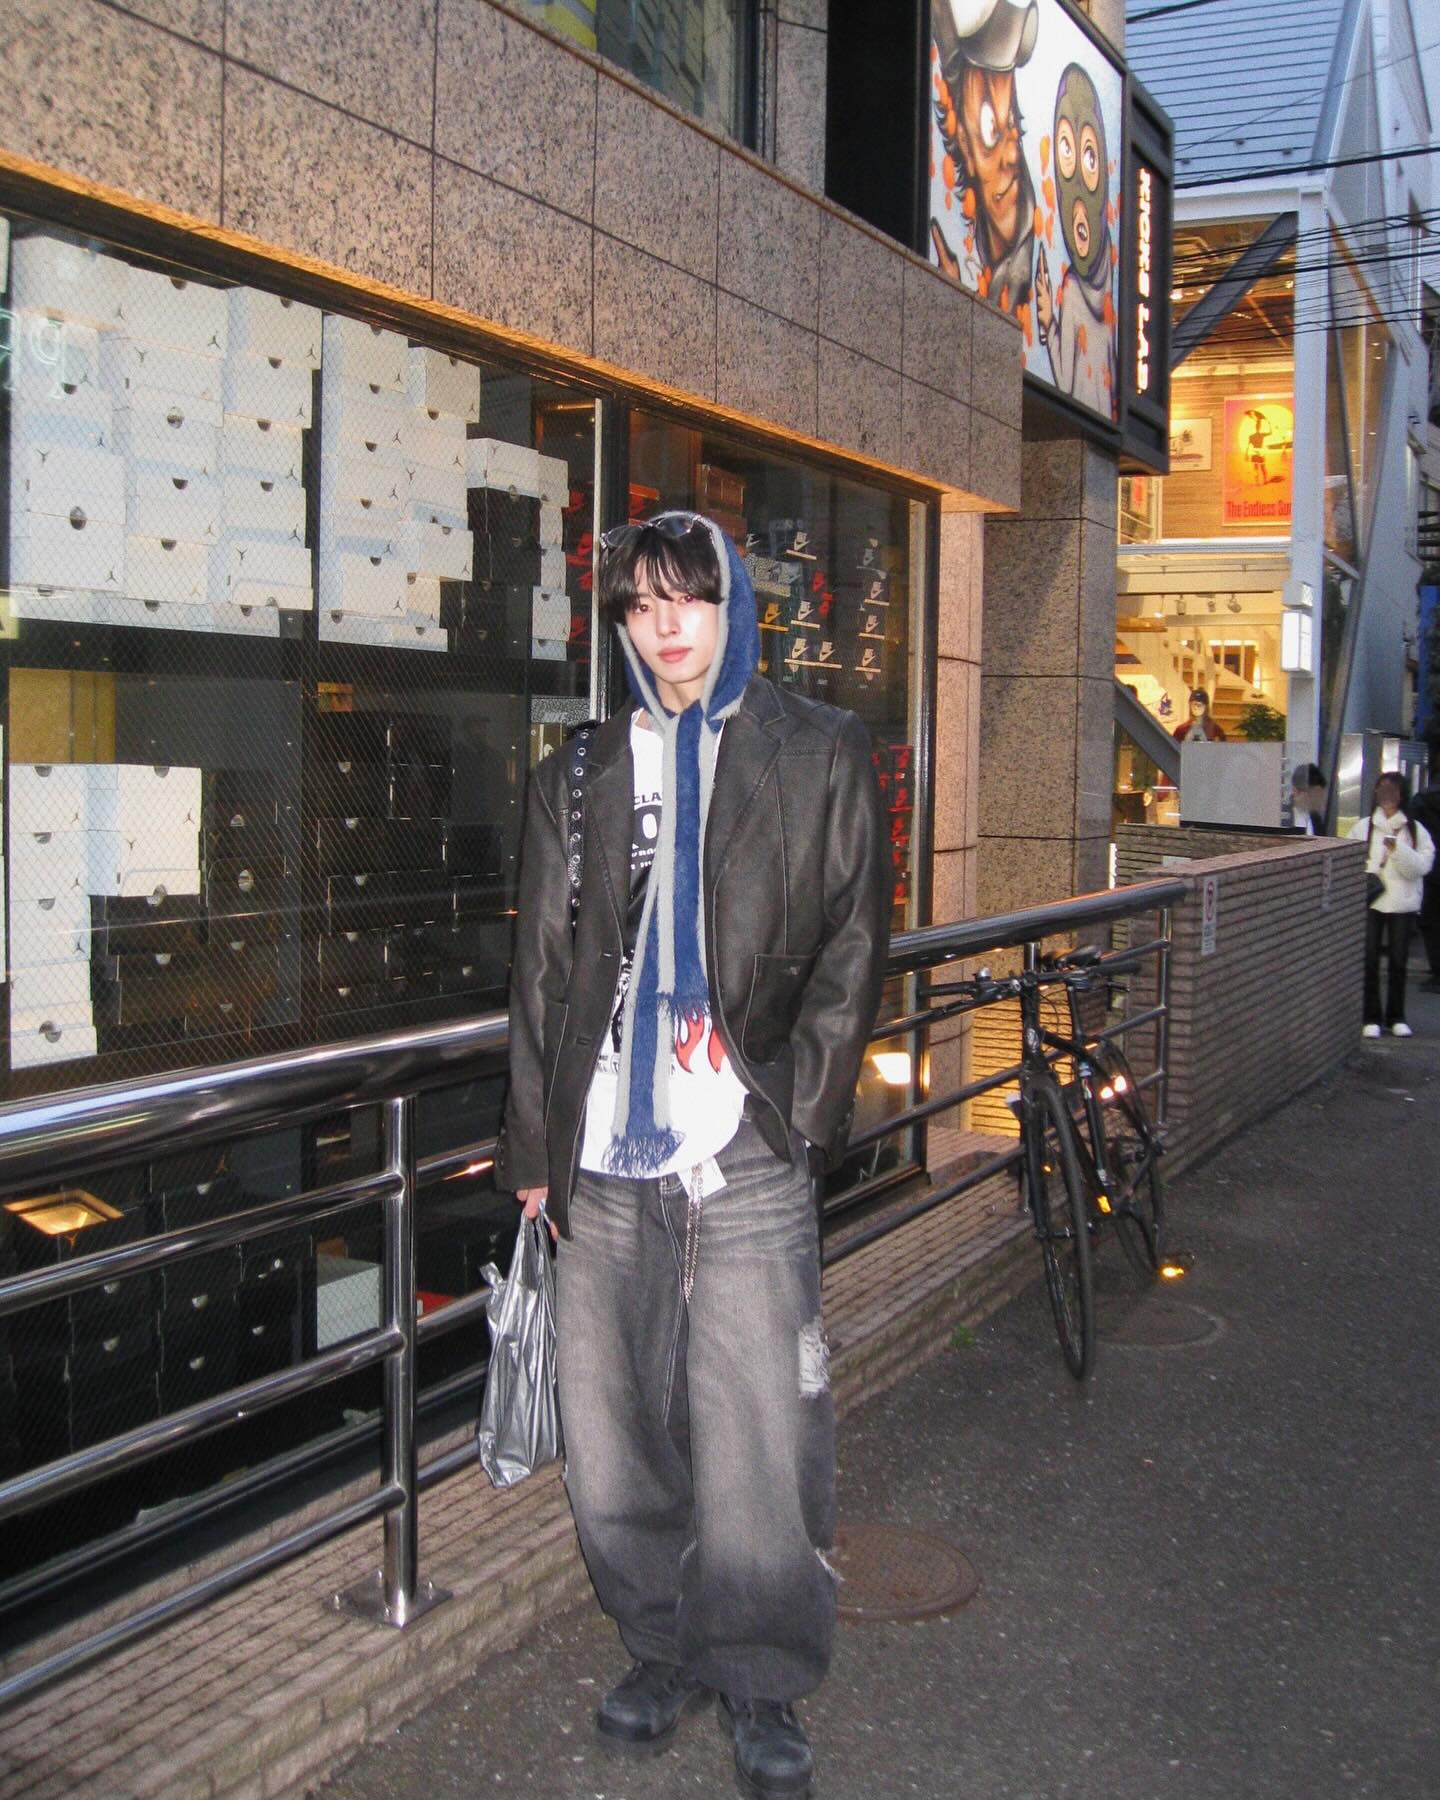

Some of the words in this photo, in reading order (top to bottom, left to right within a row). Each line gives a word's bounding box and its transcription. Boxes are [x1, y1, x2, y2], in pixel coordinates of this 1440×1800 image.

[1137, 167, 1151, 298] KICKS
[1226, 500, 1242, 518] The
[1243, 500, 1276, 517] Endless
